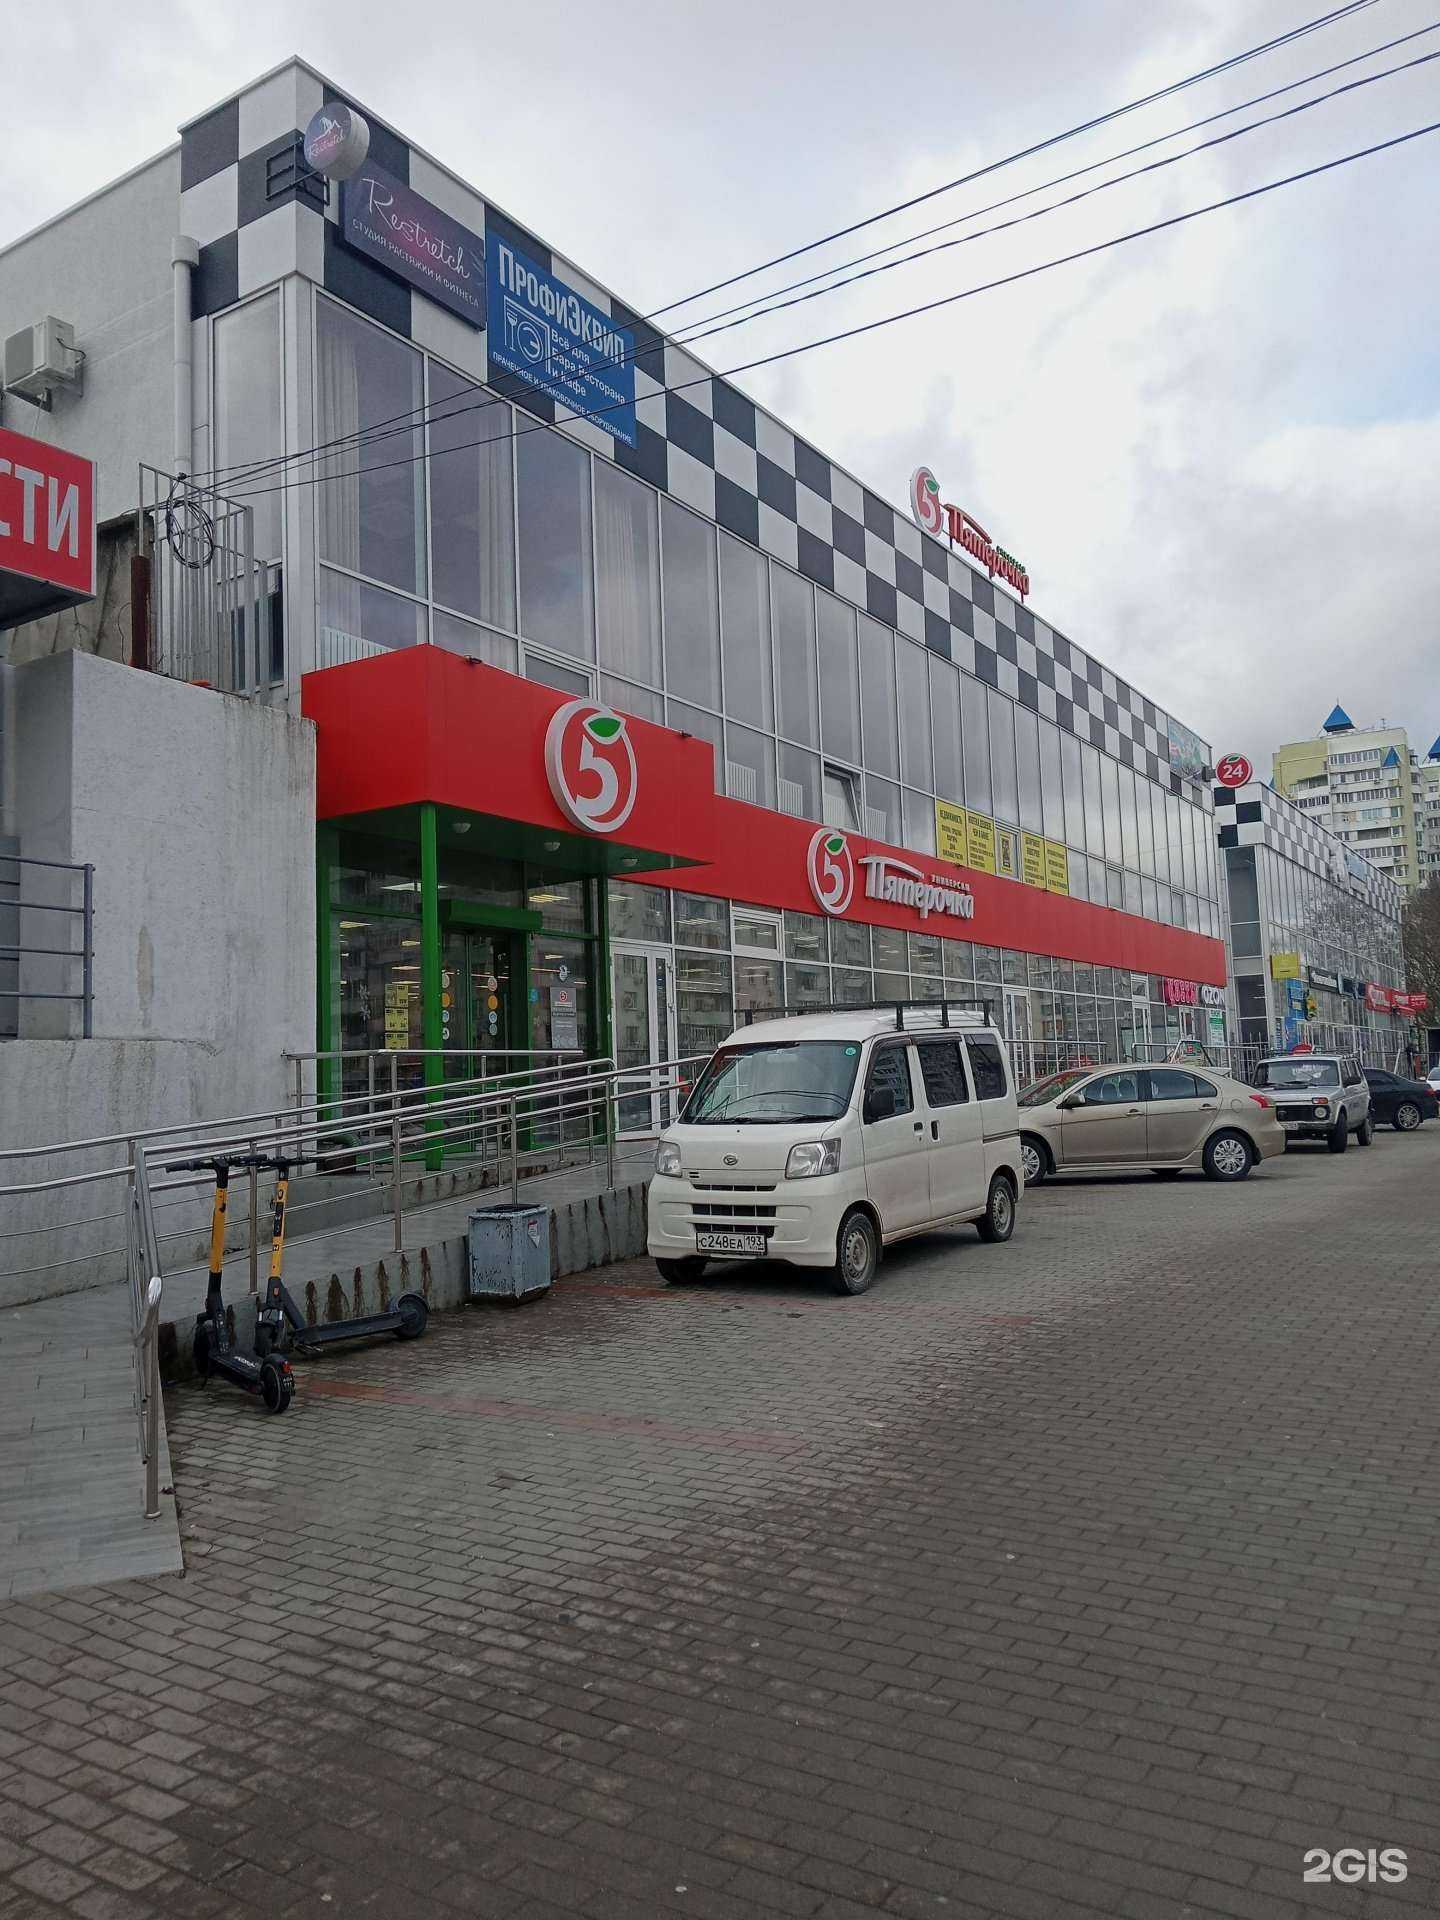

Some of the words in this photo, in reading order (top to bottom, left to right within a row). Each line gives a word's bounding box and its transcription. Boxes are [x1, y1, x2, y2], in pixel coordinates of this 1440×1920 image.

[352, 218, 386, 248] СТУДИЯ
[387, 242, 435, 279] РАСТЯЖКИ
[443, 278, 479, 307] ФИТНЕСА
[361, 178, 471, 279] Restretch
[551, 328, 571, 350] Всё
[575, 733, 619, 817] 5
[1222, 763, 1244, 779] 24
